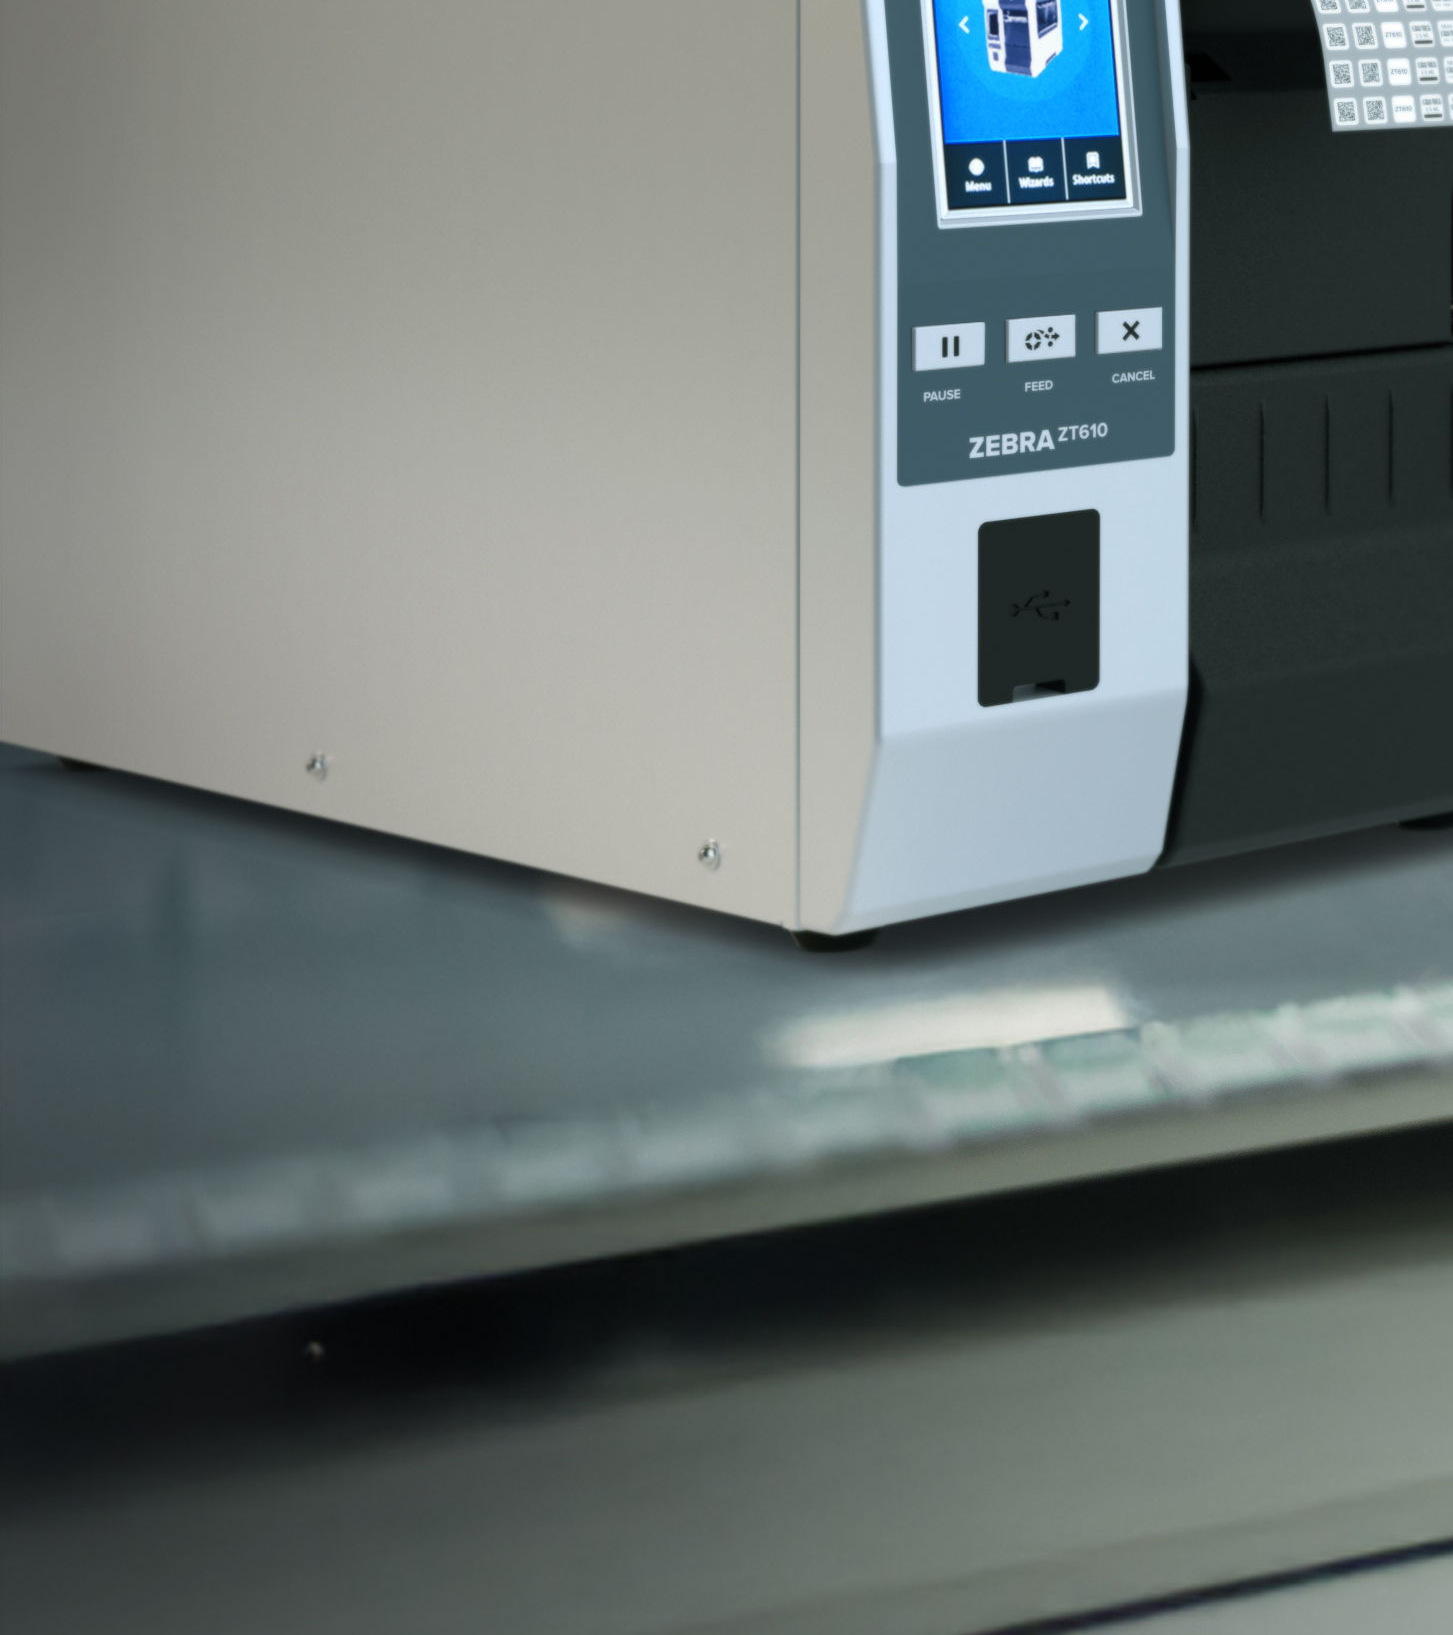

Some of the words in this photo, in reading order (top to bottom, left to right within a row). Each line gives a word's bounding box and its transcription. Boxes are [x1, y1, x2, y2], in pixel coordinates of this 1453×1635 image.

[1019, 177, 1054, 189] Wizards
[1073, 173, 1115, 186] Shortcuts
[965, 181, 991, 192] Menu
[1111, 370, 1155, 383] CANCEL
[1024, 380, 1053, 392] FEED
[923, 389, 961, 402] PAUSE
[969, 430, 1055, 459] ZEBRA
[1057, 423, 1109, 442] ZT610
